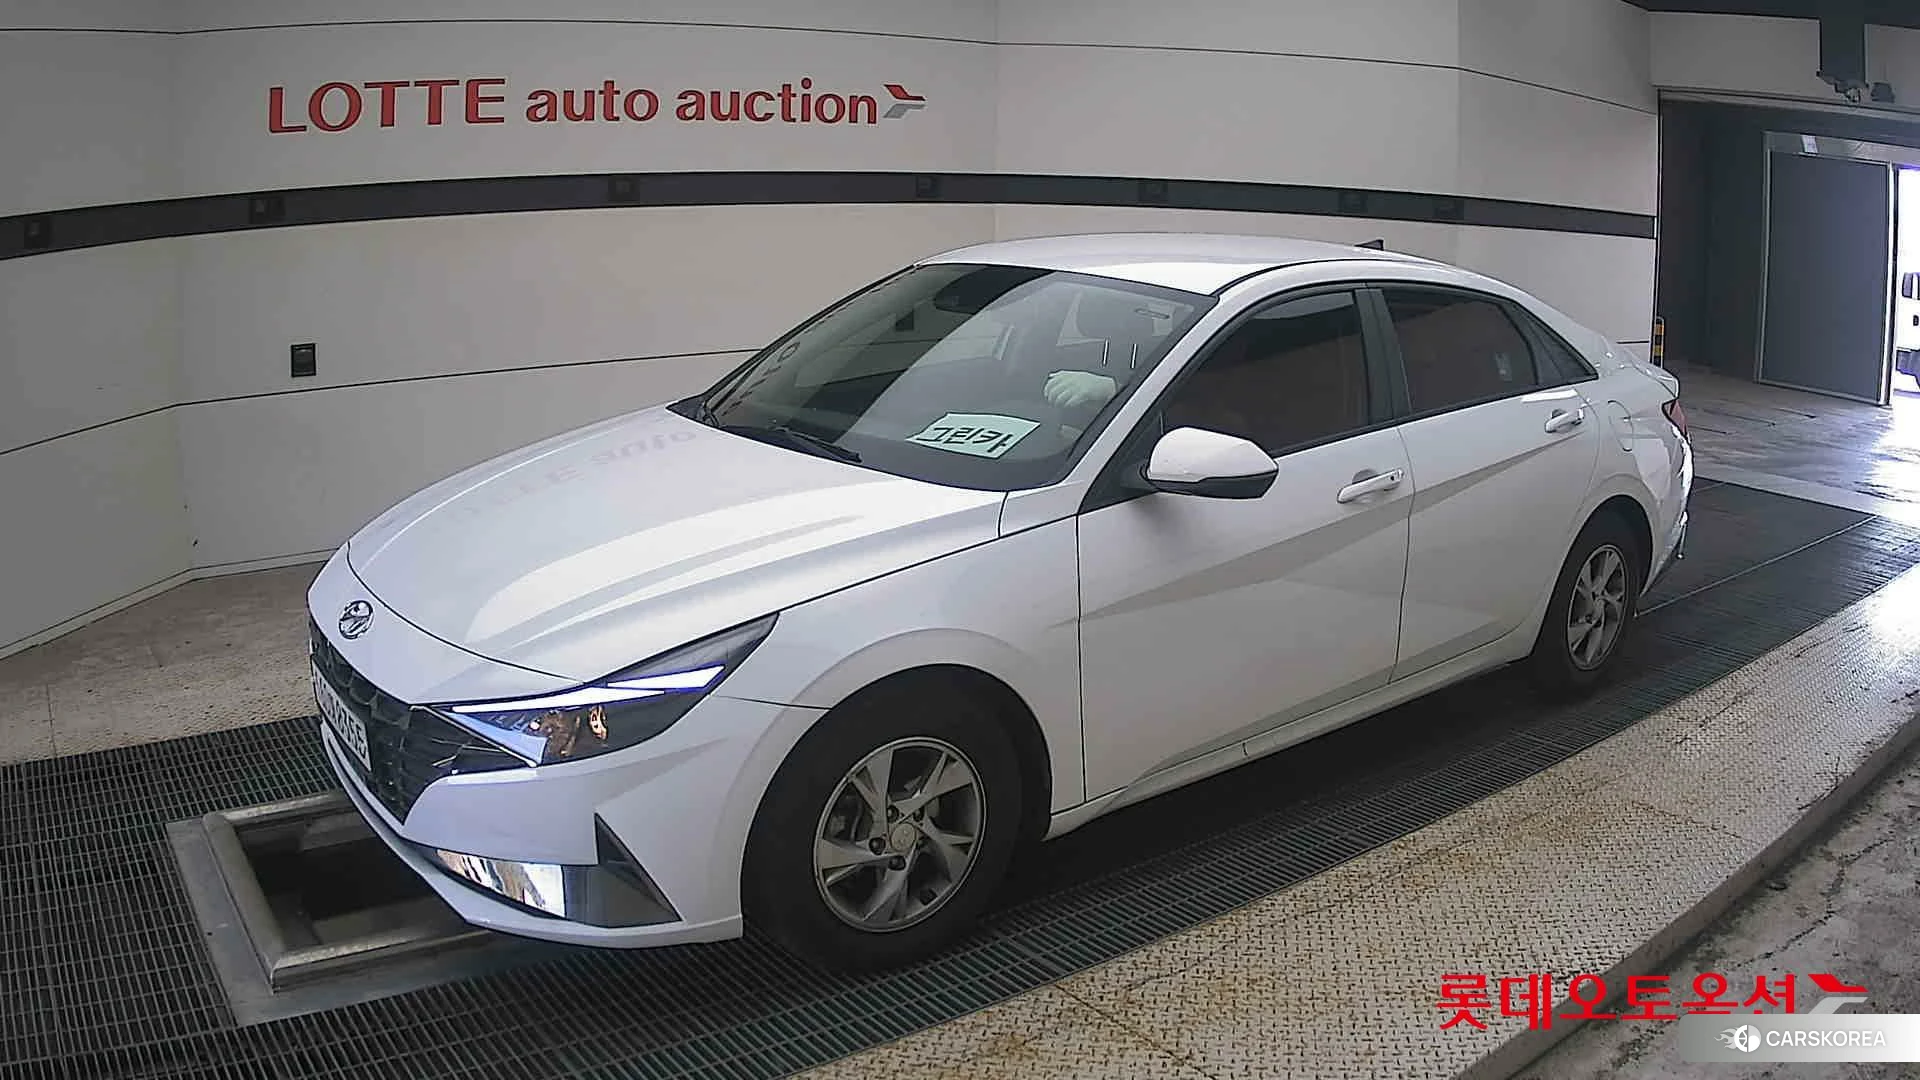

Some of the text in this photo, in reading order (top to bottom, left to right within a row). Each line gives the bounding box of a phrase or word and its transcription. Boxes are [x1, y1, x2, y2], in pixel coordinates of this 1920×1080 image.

[268, 78, 877, 133] LOTTE auto auction
[915, 426, 1013, 453] 그린카
